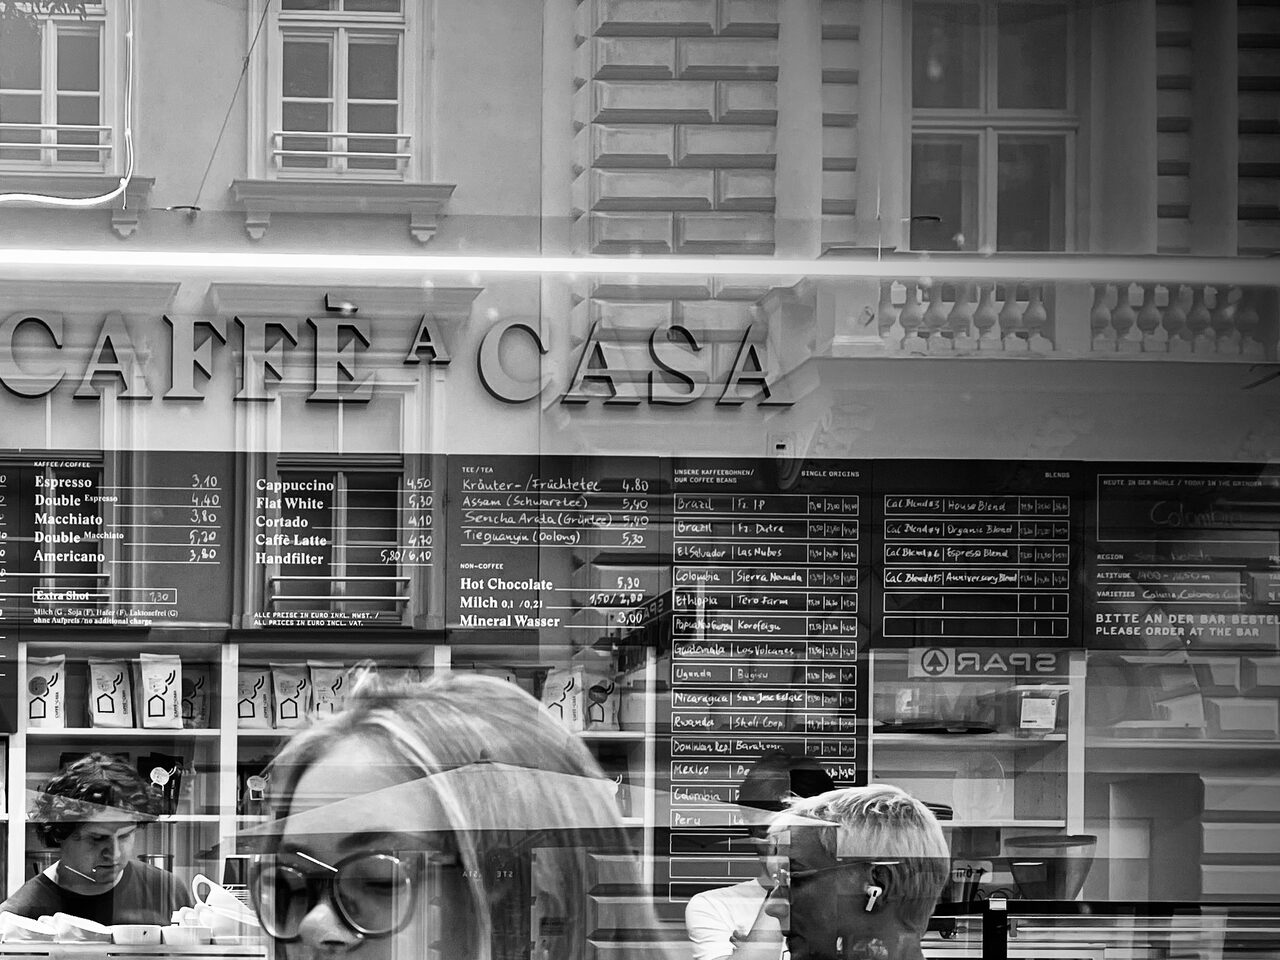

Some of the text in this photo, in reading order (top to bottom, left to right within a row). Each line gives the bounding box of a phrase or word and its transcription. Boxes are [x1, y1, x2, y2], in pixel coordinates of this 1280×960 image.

[403, 313, 451, 365] A
[476, 320, 797, 409] CASA
[35, 474, 217, 490] Espresso 3,10
[256, 478, 431, 493] Cappuccino 4,50
[35, 493, 219, 507] Double Espresso 4,40
[256, 495, 432, 510] Flat White 5,30
[463, 495, 648, 510] Assam (Schwarztee) 5,40
[677, 498, 714, 510] Brazil
[977, 501, 1006, 511] Blend
[35, 509, 216, 525] Macchiato 3,80
[256, 515, 432, 528] Cortado 4,10
[464, 511, 648, 527] Sencha 5,40
[677, 522, 712, 533] Brazil
[947, 526, 983, 536] Organic
[34, 529, 216, 546] Double Macchiato 5,20
[255, 534, 432, 546] Caffè Latte 4,70
[533, 531, 580, 544] (Oolong)
[621, 534, 643, 545] 5,30
[34, 549, 216, 562] Americano 3,80
[737, 547, 752, 556] Las
[984, 549, 1008, 558] Blend
[255, 552, 323, 564] Handfilter
[676, 570, 768, 582] Colombia Sierra
[460, 577, 639, 590] Hot Chocolate 5,30
[37, 591, 65, 600] Extra
[67, 591, 89, 600] Shot
[460, 597, 498, 608] Milch
[68, 609, 82, 617] Soja
[130, 609, 166, 617] Laktosefrei
[1096, 614, 1225, 624] BITTE AN DER BAR
[52, 617, 79, 625] Aufpreis
[460, 612, 642, 627] Mineral Wasser 3,00
[1096, 627, 1259, 637] PLEASE ORDER AT THE BAR
[676, 670, 711, 679] Uganda
[675, 694, 728, 705] Nicaragua
[674, 717, 714, 727] Rwanda
[674, 765, 709, 774] Mexico
[674, 788, 720, 801] Colombia
[675, 813, 700, 825] Peru
